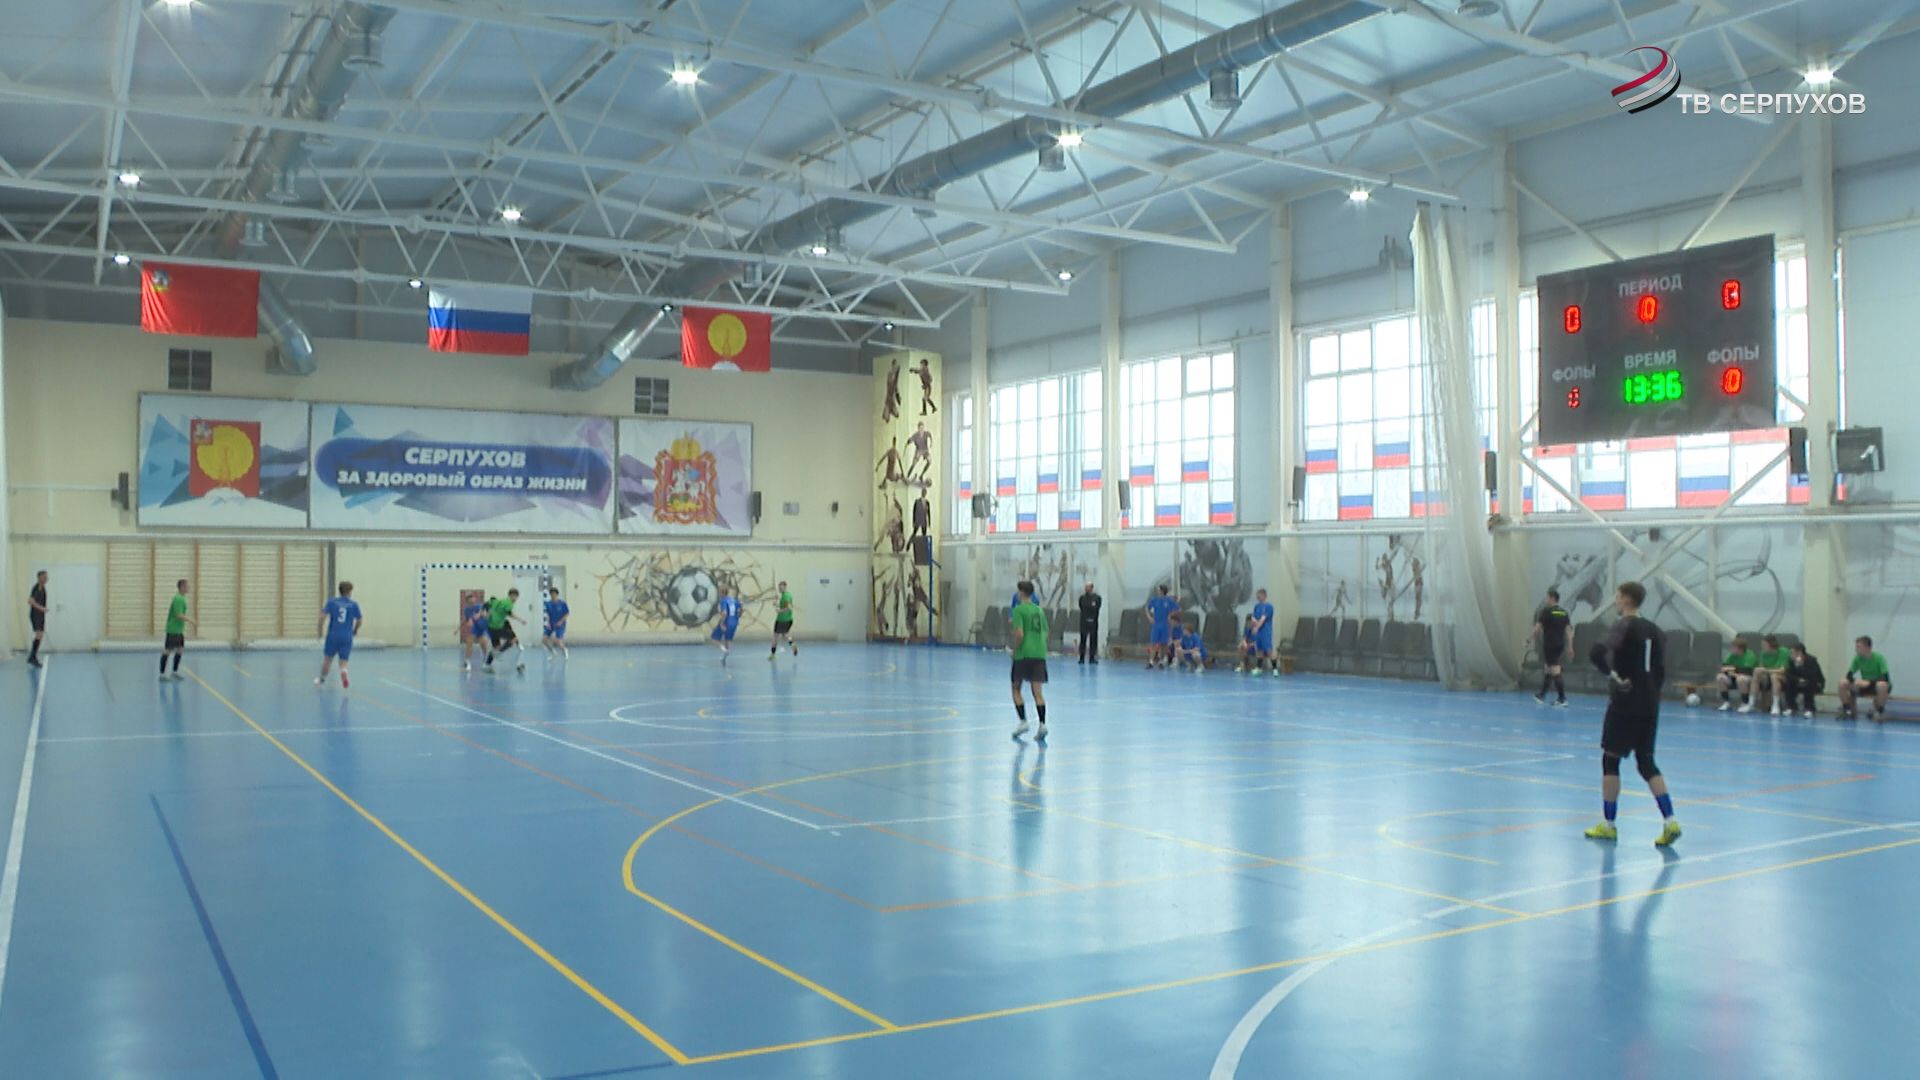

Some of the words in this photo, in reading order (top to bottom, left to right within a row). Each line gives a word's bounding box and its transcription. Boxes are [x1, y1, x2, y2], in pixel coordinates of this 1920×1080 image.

[1618, 273, 1683, 298] ПЕРИОД
[1565, 305, 1580, 332] 0
[1639, 295, 1657, 322] 0
[1624, 349, 1677, 369] ВРЕМЯ
[1624, 370, 1681, 402] 13:36
[1723, 368, 1742, 394] 0
[404, 447, 527, 468] СЕРПУХОВ
[337, 470, 360, 485] ЗА
[365, 471, 466, 488] ЗДОРОВЫЙ
[469, 474, 523, 489] ОБРАЗ
[527, 475, 588, 491] ЖИЗНИ
[337, 607, 347, 623] 3
[1645, 638, 1652, 673] 1
